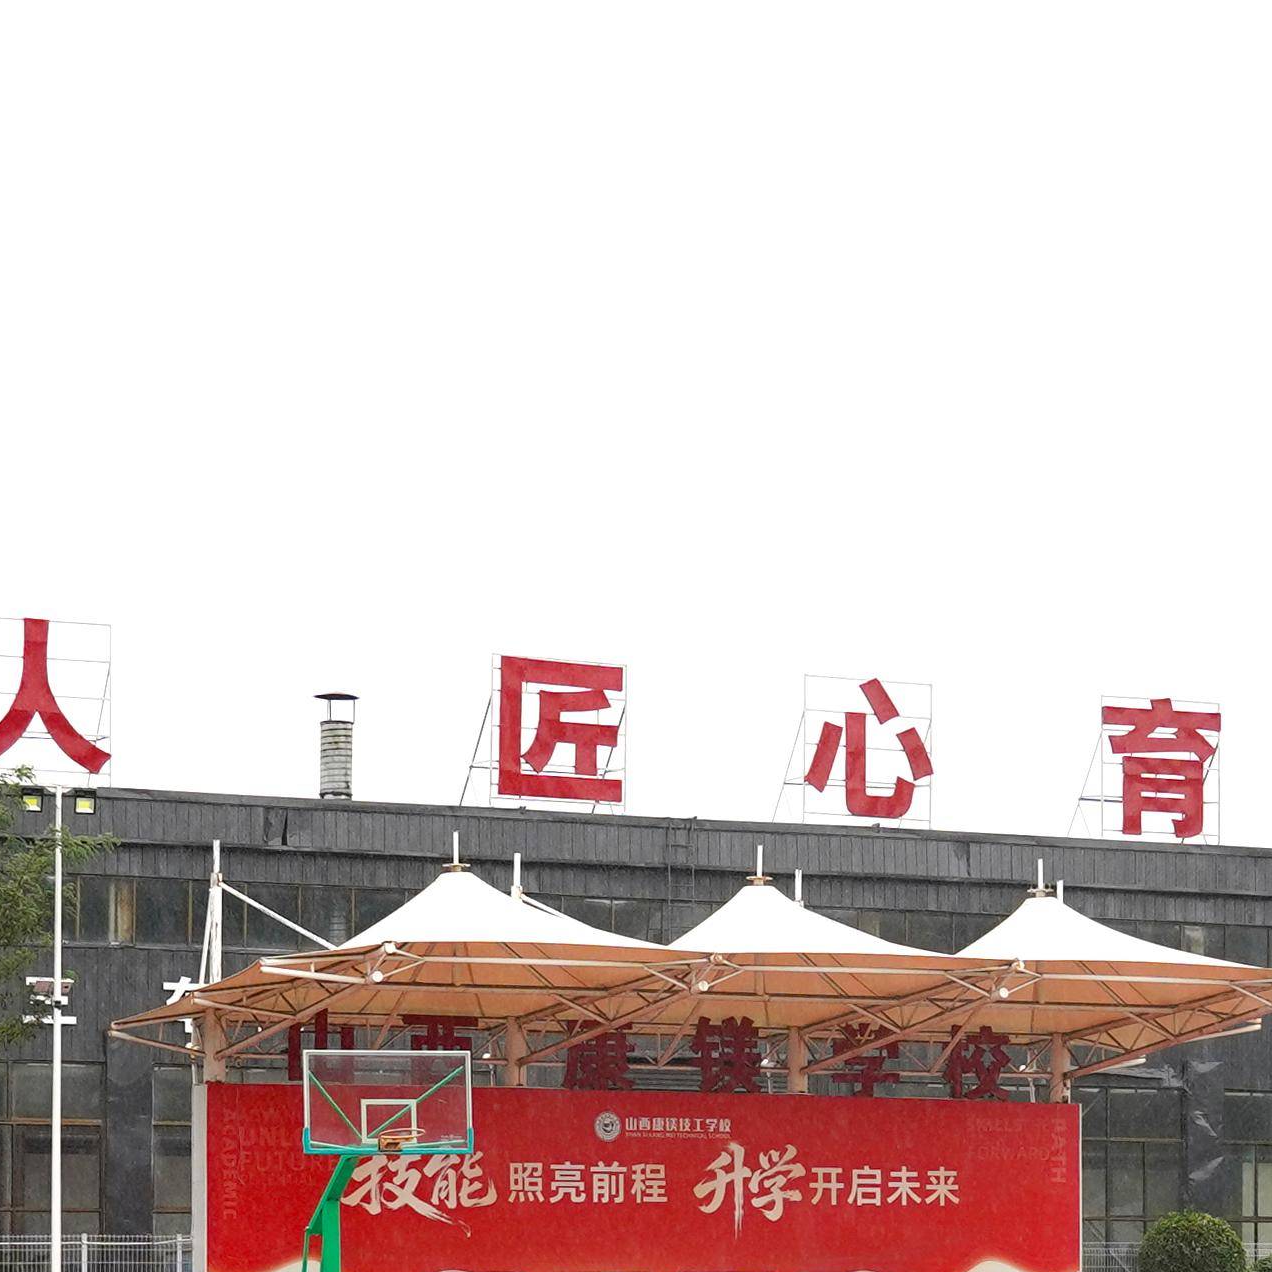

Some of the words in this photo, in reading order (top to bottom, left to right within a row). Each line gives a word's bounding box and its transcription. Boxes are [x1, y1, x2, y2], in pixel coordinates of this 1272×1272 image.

[340, 1151, 498, 1238] 技能
[507, 1161, 669, 1204] 照亮前程
[692, 1142, 806, 1240] 升学
[809, 1165, 961, 1207] 开启未来
